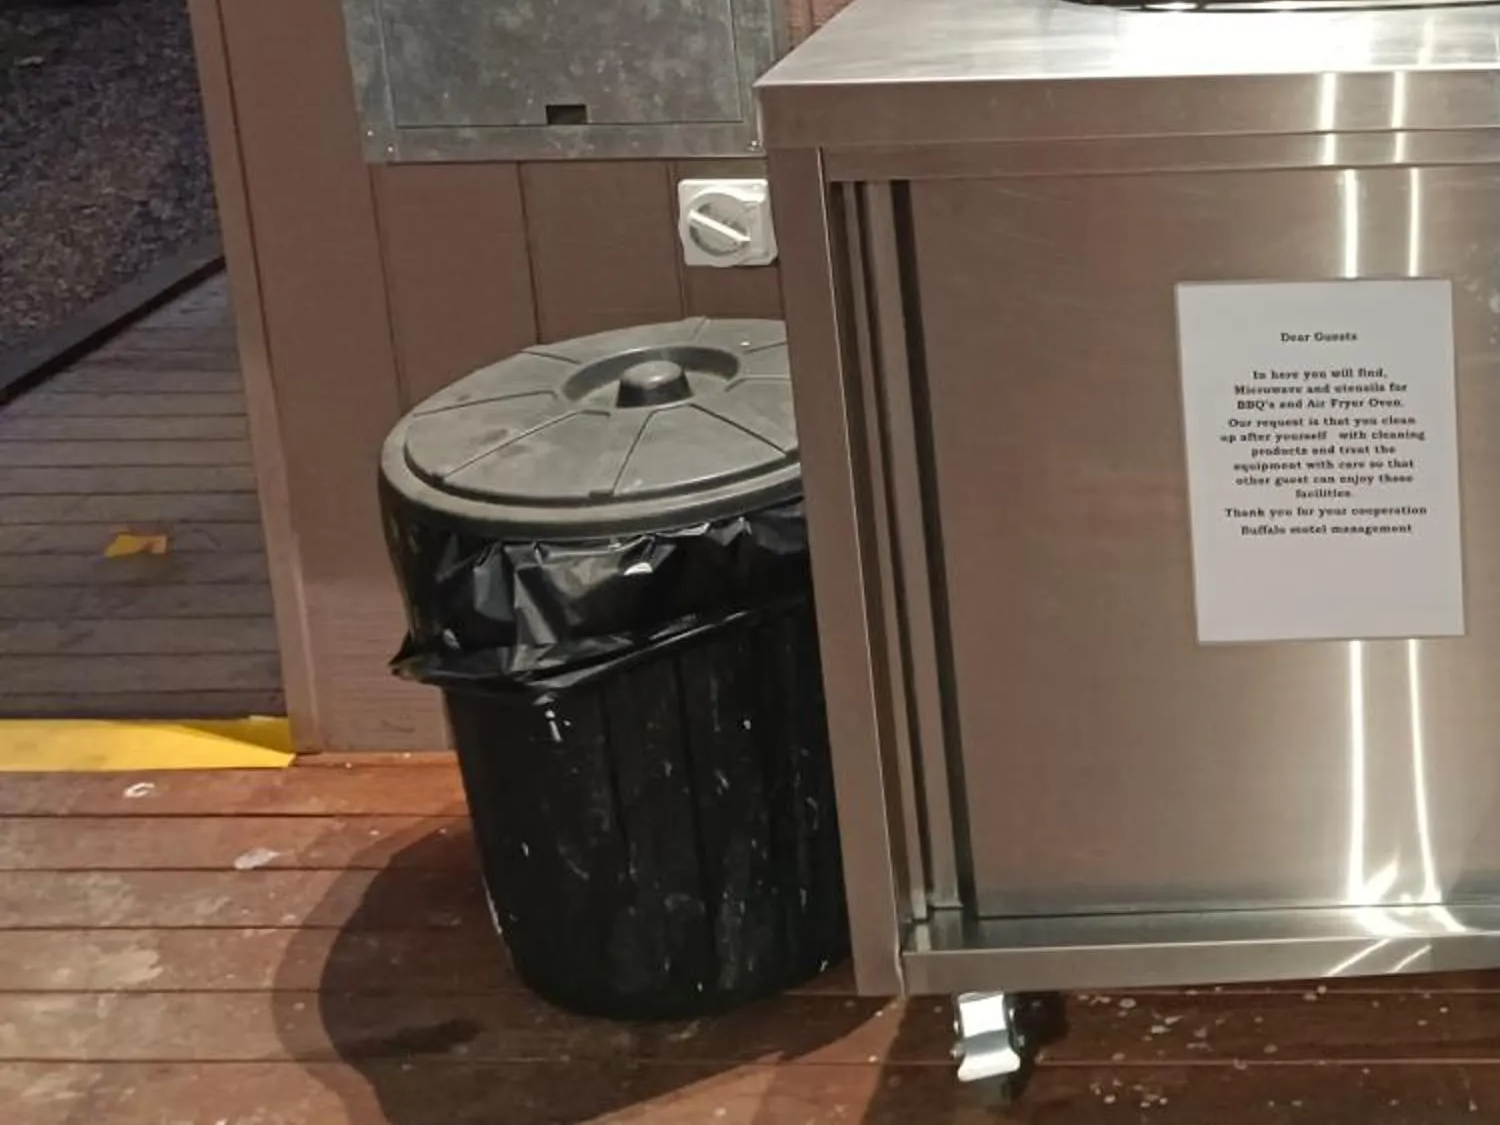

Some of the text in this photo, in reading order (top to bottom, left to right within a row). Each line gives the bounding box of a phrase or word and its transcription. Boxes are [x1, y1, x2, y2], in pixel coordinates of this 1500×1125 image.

[1280, 331, 1358, 342] Dear Guests
[1270, 370, 1300, 380] here
[1304, 371, 1327, 381] you
[1330, 368, 1354, 378] will
[1234, 384, 1304, 395] Microwave
[1306, 383, 1331, 394] and
[1389, 382, 1407, 392] for
[1279, 399, 1303, 409] and
[1305, 399, 1326, 408] Air
[1330, 398, 1365, 410] Fryer
[1227, 415, 1416, 429] Our request is that you clean
[1220, 429, 1426, 444] up after yourself with cleaning
[1251, 444, 1397, 458] products and treat the
[1233, 458, 1415, 473] equipment with care so that
[1236, 475, 1271, 486] other
[1313, 476, 1338, 484] can
[1339, 474, 1375, 486] enjoy
[1378, 473, 1414, 483] these
[1224, 506, 1427, 519] Thank you for your cooperation
[1241, 524, 1412, 536] Buffalo motel management
